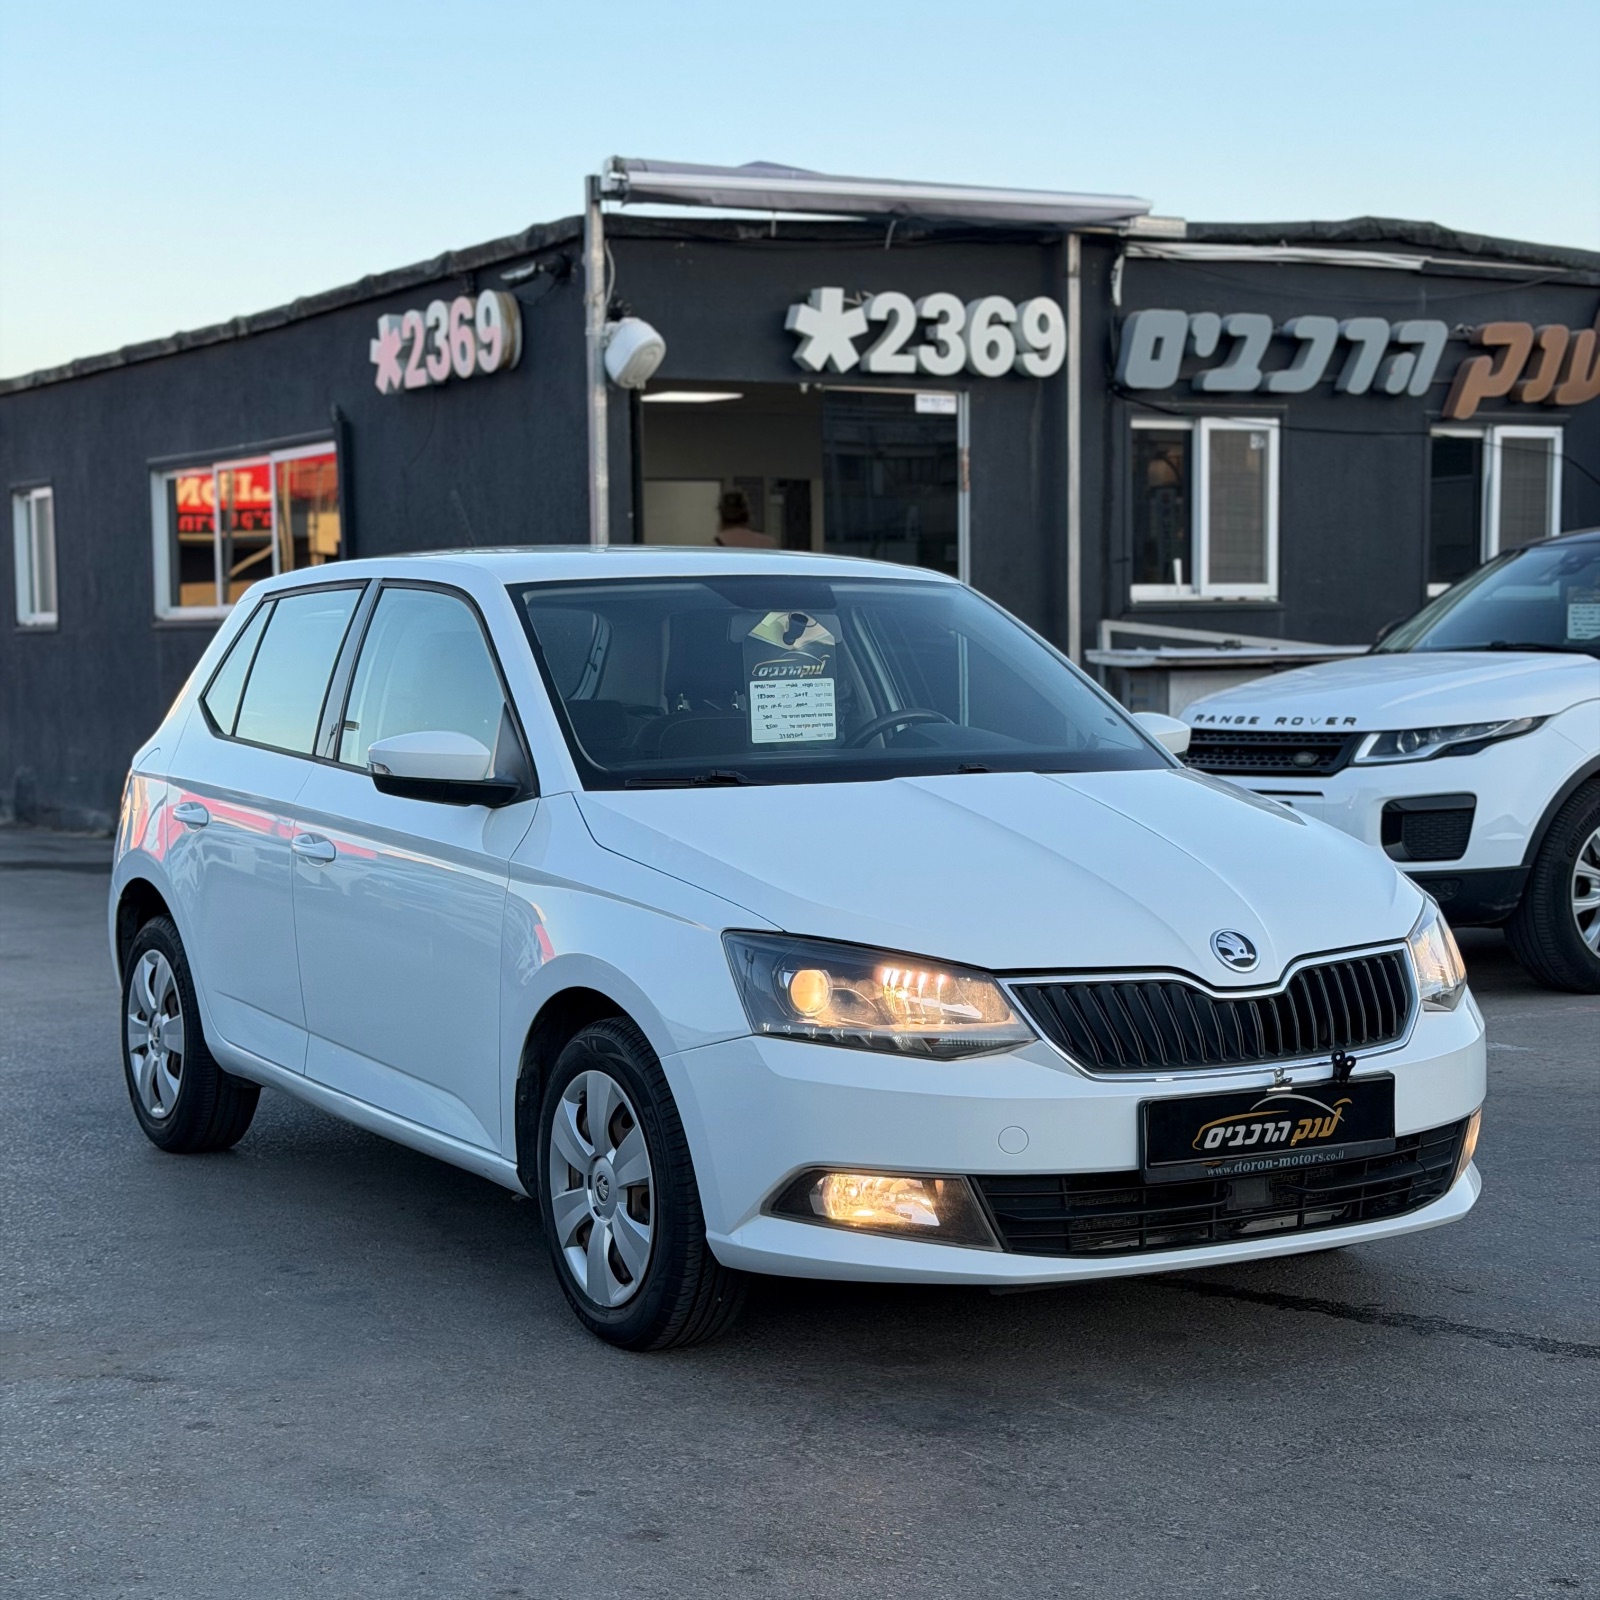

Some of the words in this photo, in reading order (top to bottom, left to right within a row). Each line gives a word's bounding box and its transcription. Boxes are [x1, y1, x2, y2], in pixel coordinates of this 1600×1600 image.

[1117, 309, 1449, 397] הרכבים
[758, 665, 801, 677] הרכבים
[800, 660, 826, 678] ענק
[1193, 713, 1261, 726] RANGE
[1274, 716, 1358, 727] ROVER
[1203, 1120, 1293, 1149] הרכבים
[1290, 1106, 1343, 1147] ענק
[1206, 1149, 1345, 1177] www.doron-motors.co.il
